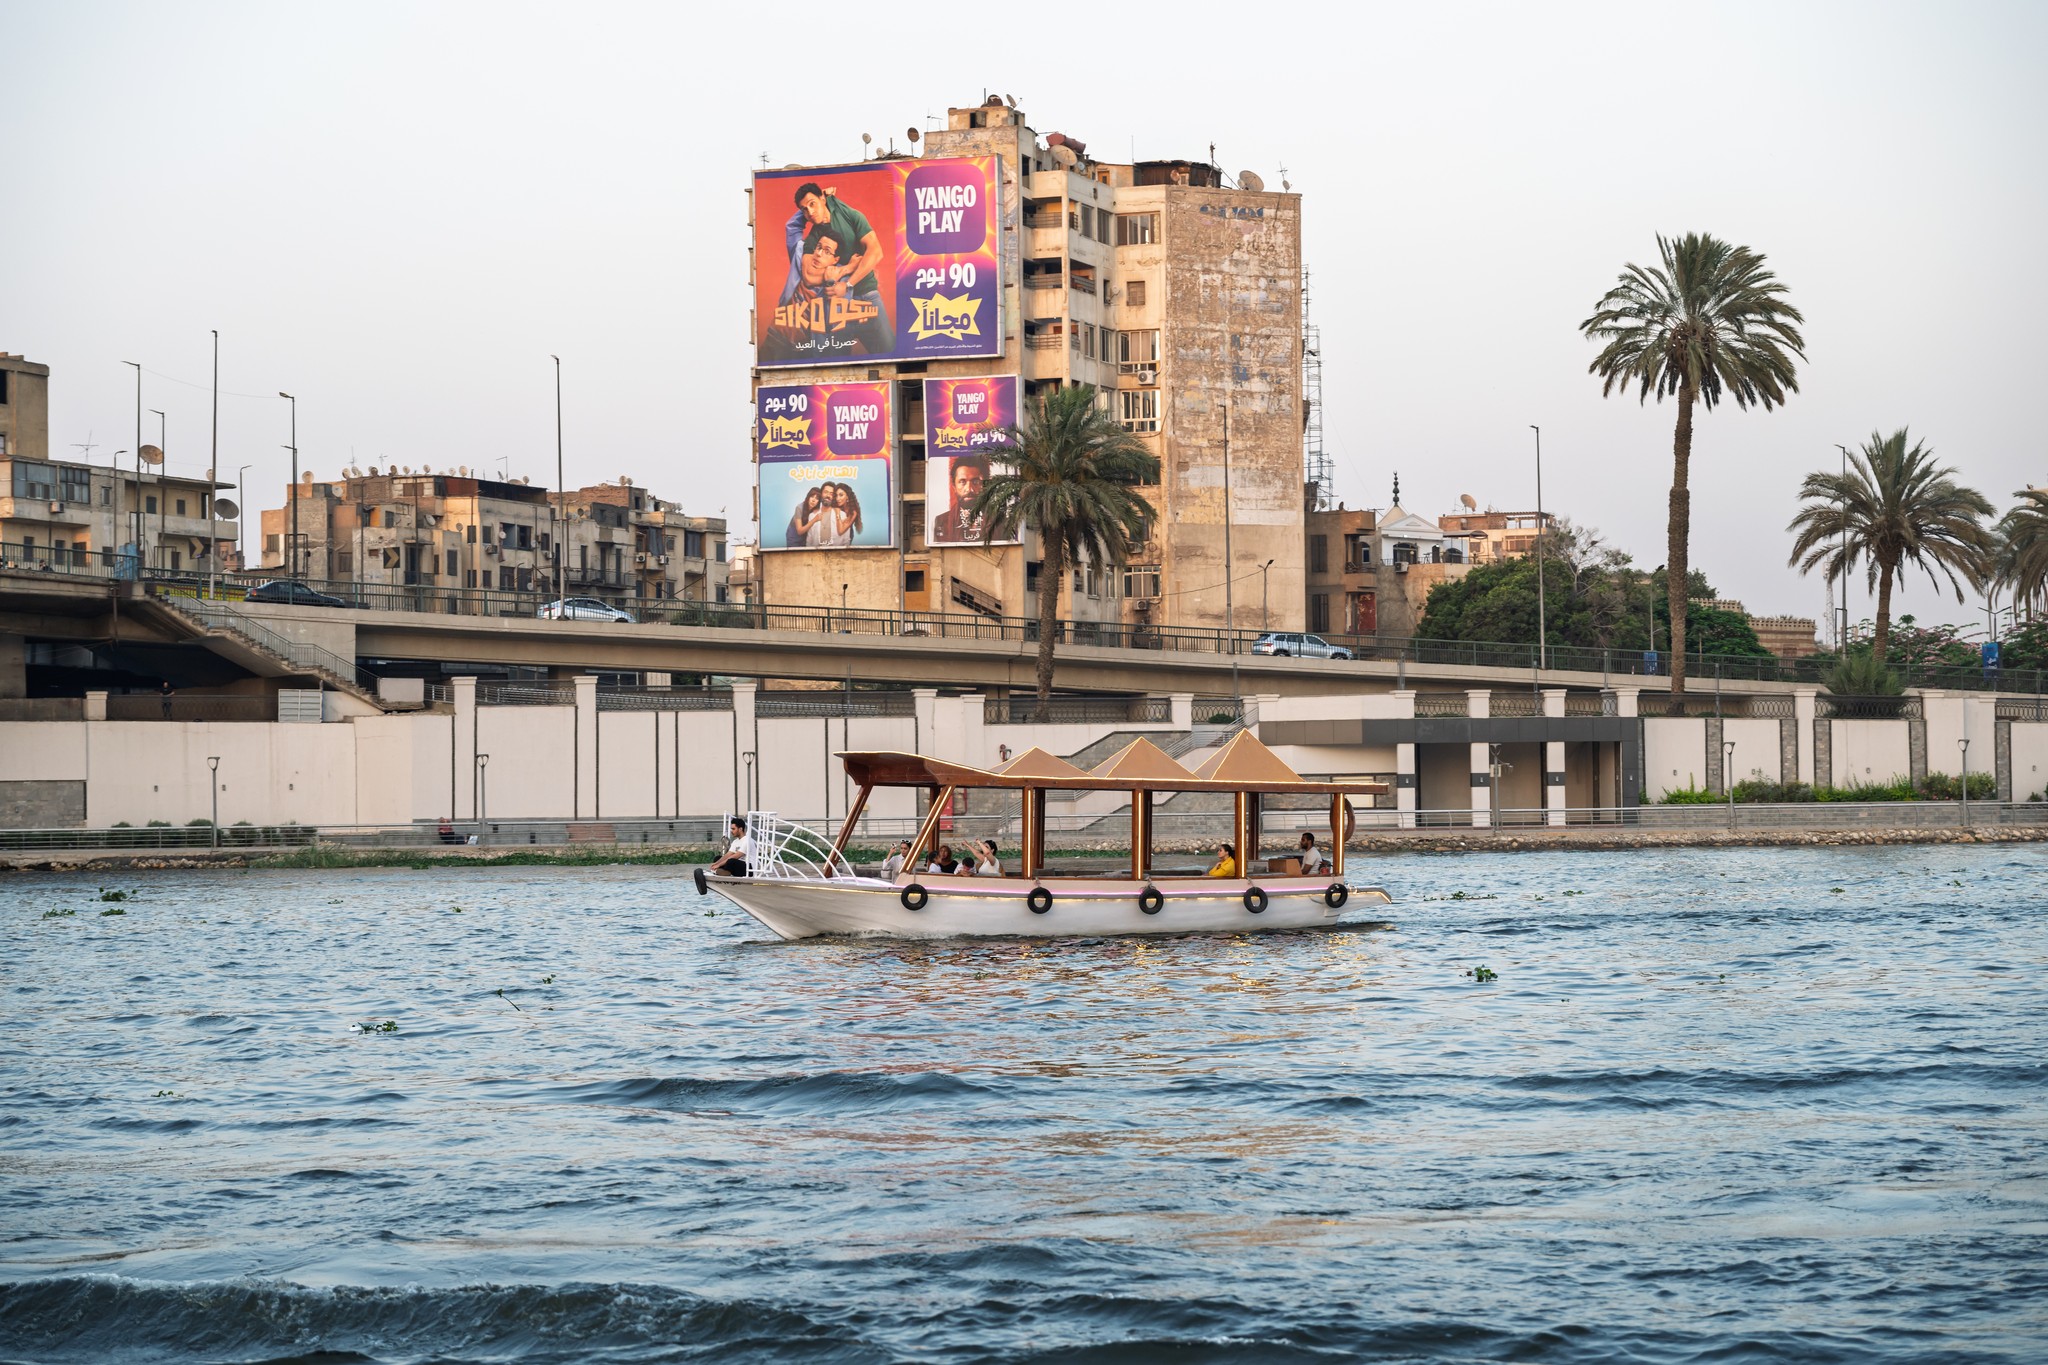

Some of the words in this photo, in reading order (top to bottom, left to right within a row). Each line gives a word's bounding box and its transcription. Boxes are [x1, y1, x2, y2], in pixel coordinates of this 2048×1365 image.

[914, 184, 977, 210] YANGO
[918, 210, 964, 235] PLAY
[915, 267, 946, 290] يوم
[949, 262, 977, 289] 90
[774, 297, 826, 333] SIKO
[829, 296, 879, 332] سيكو
[922, 301, 971, 334] مجاناً
[795, 339, 816, 351] العيد
[817, 337, 831, 352] في
[765, 397, 787, 413] يوم
[788, 393, 808, 412] 90
[956, 391, 985, 404] YANGO
[833, 404, 879, 423] YANGO
[958, 403, 979, 415] PLAY
[836, 422, 869, 440] PLAY
[970, 432, 989, 445] يوم
